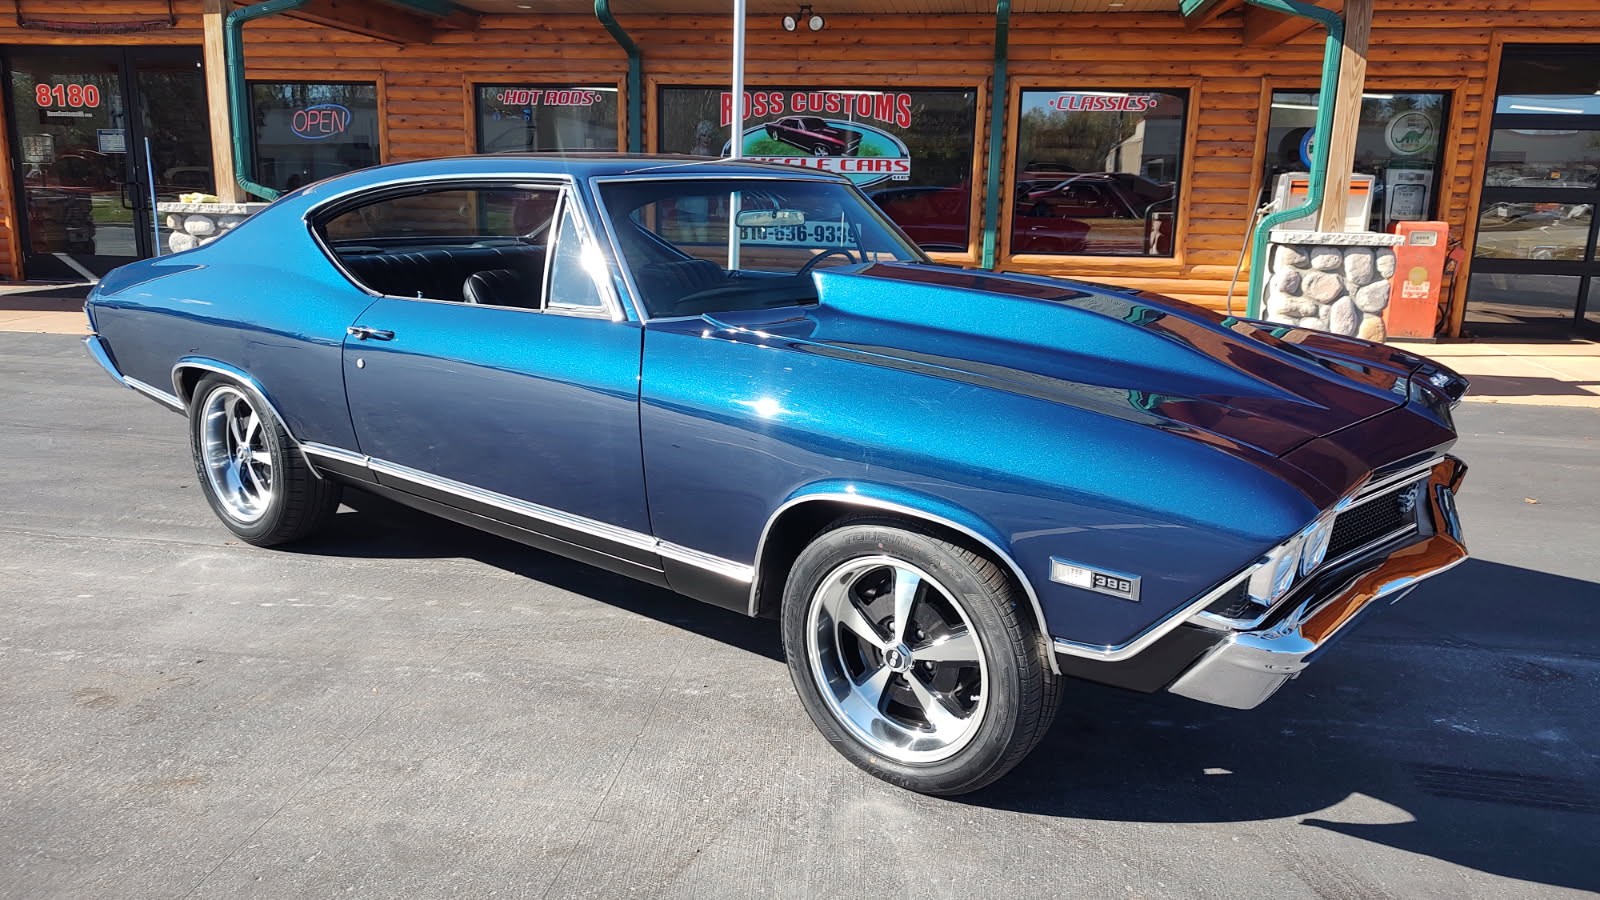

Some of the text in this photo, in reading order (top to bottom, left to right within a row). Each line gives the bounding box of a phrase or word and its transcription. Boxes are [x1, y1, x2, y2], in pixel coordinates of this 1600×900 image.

[36, 84, 100, 107] 8180
[503, 89, 595, 106] HOT RODS
[1056, 95, 1150, 111] CLASSICS
[720, 91, 912, 128] ROSS CUSTOMS
[293, 110, 346, 133] OPEN
[840, 159, 909, 172] CARS
